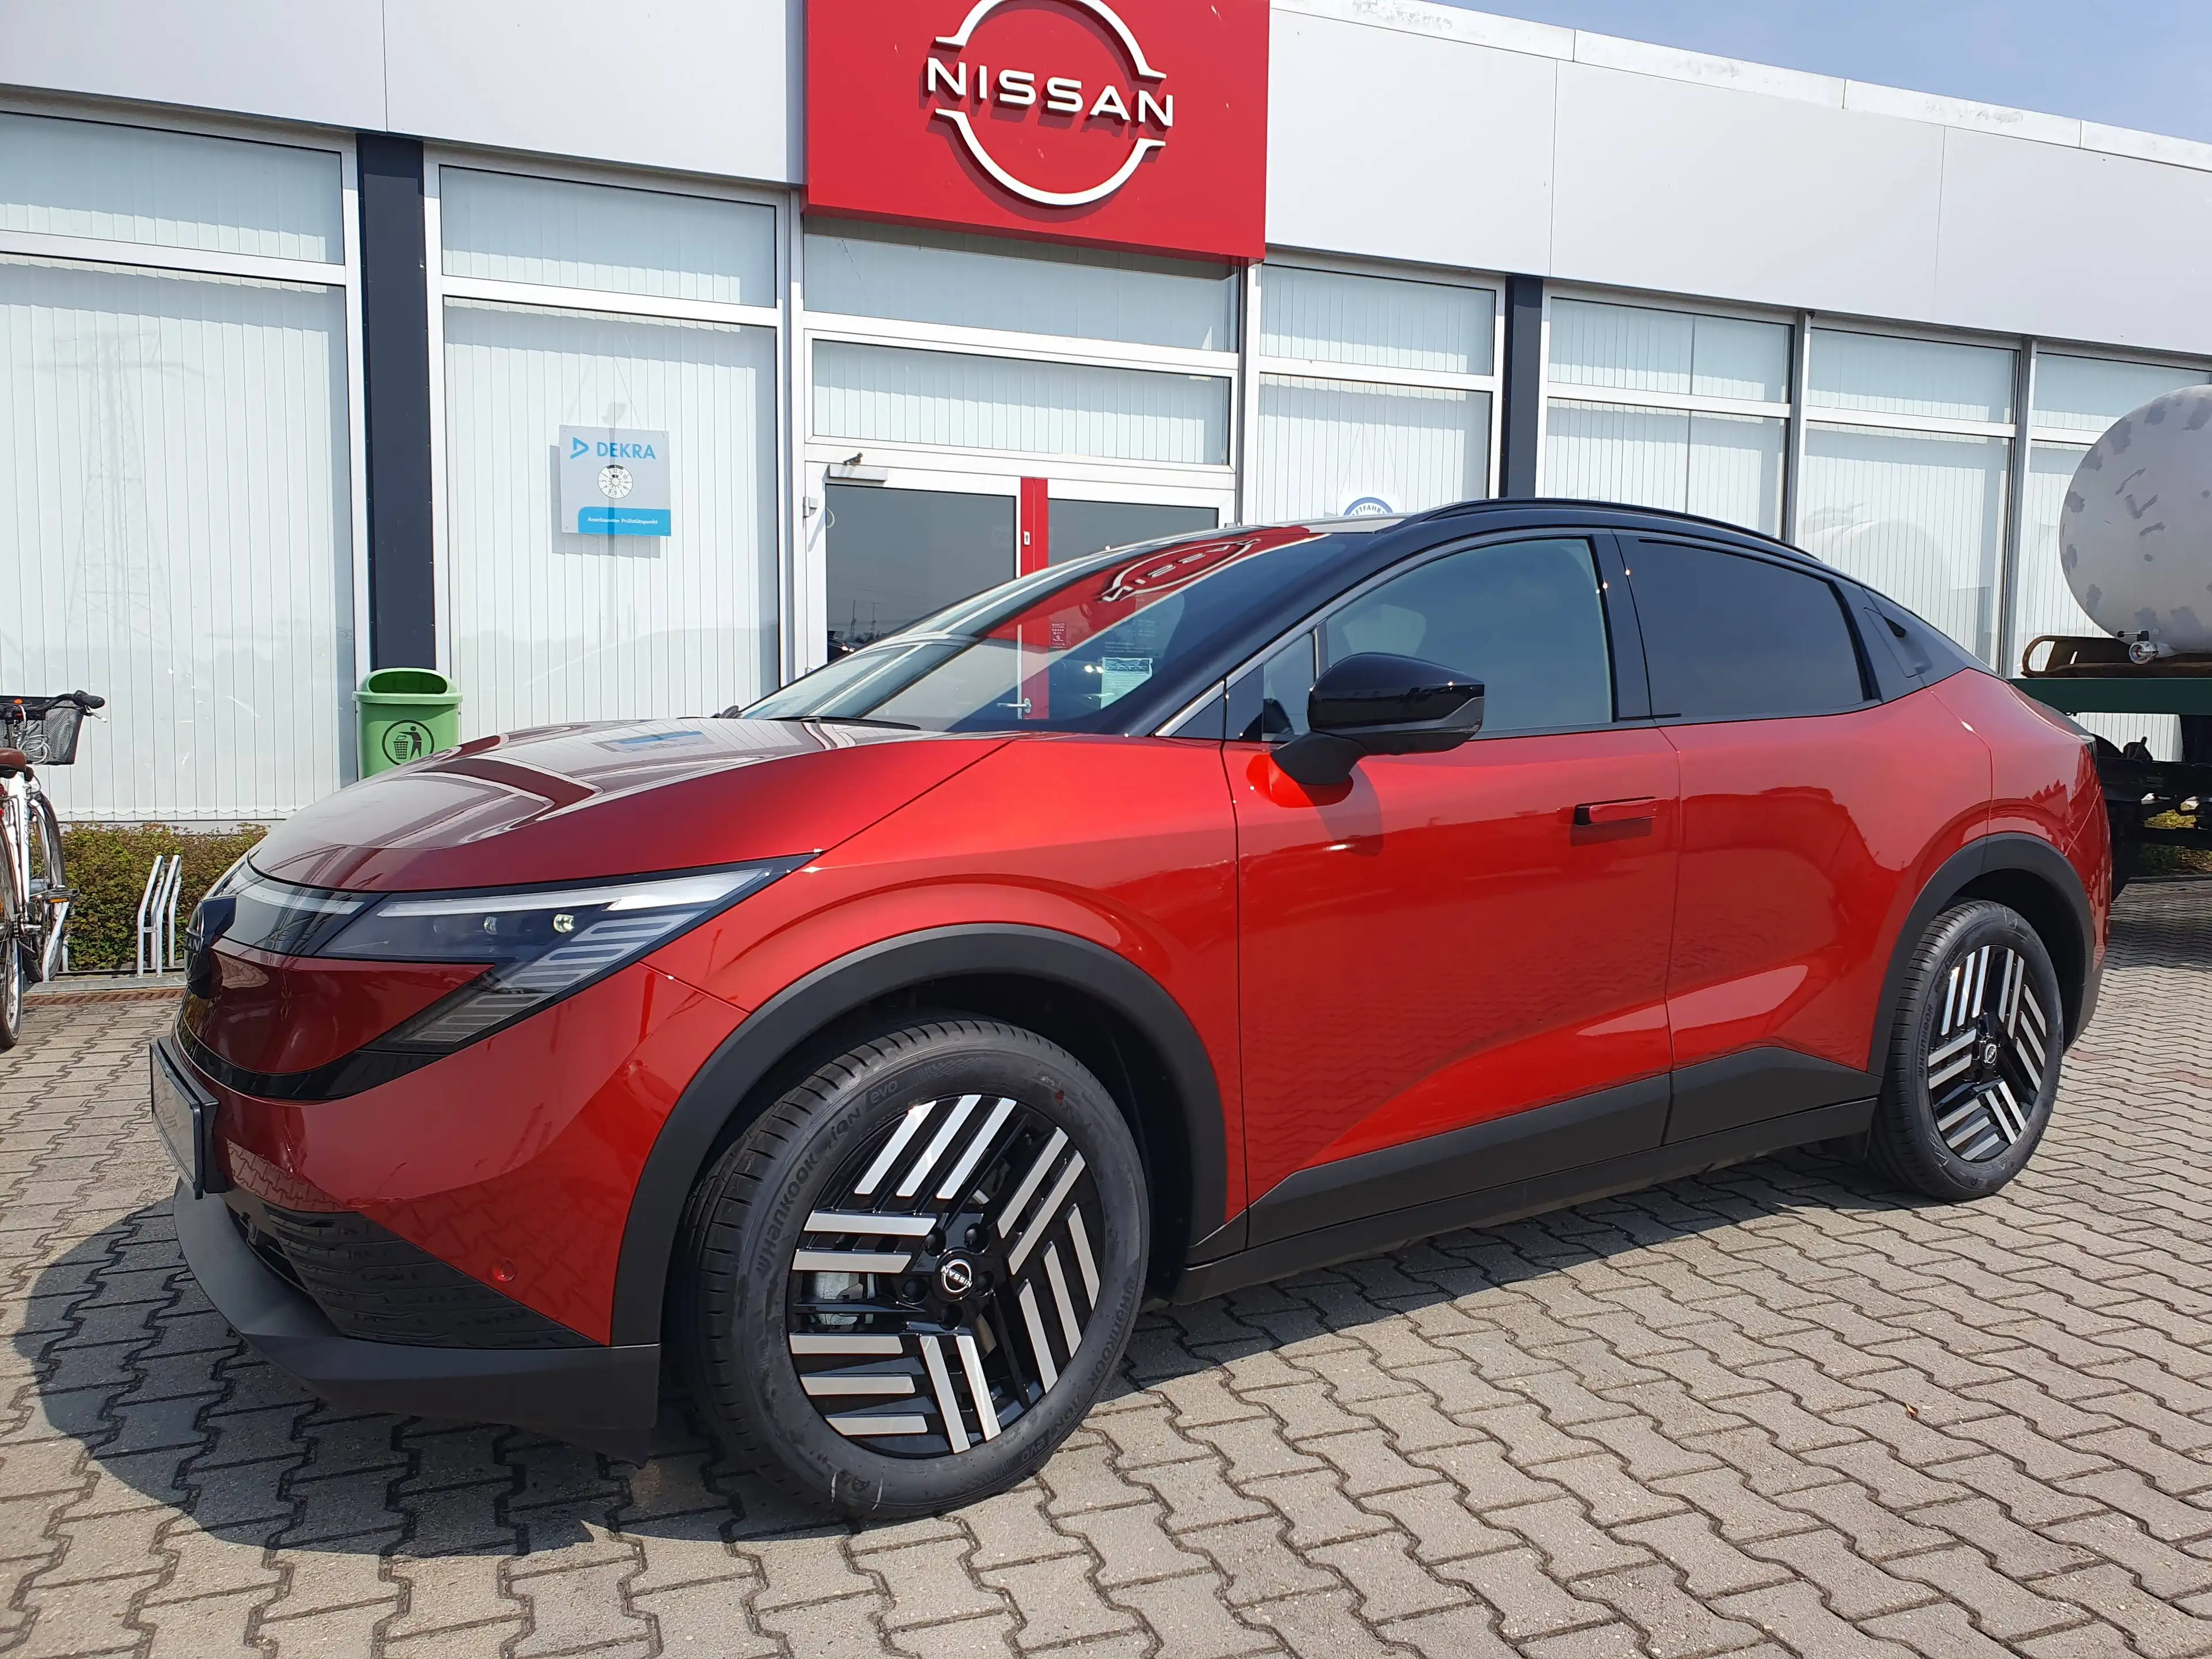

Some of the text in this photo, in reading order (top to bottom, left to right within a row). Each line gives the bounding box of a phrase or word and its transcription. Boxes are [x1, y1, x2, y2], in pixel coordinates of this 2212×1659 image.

[927, 57, 1173, 127] NISSAN
[597, 441, 656, 460] DEKRA
[940, 1265, 973, 1287] NISSAN
